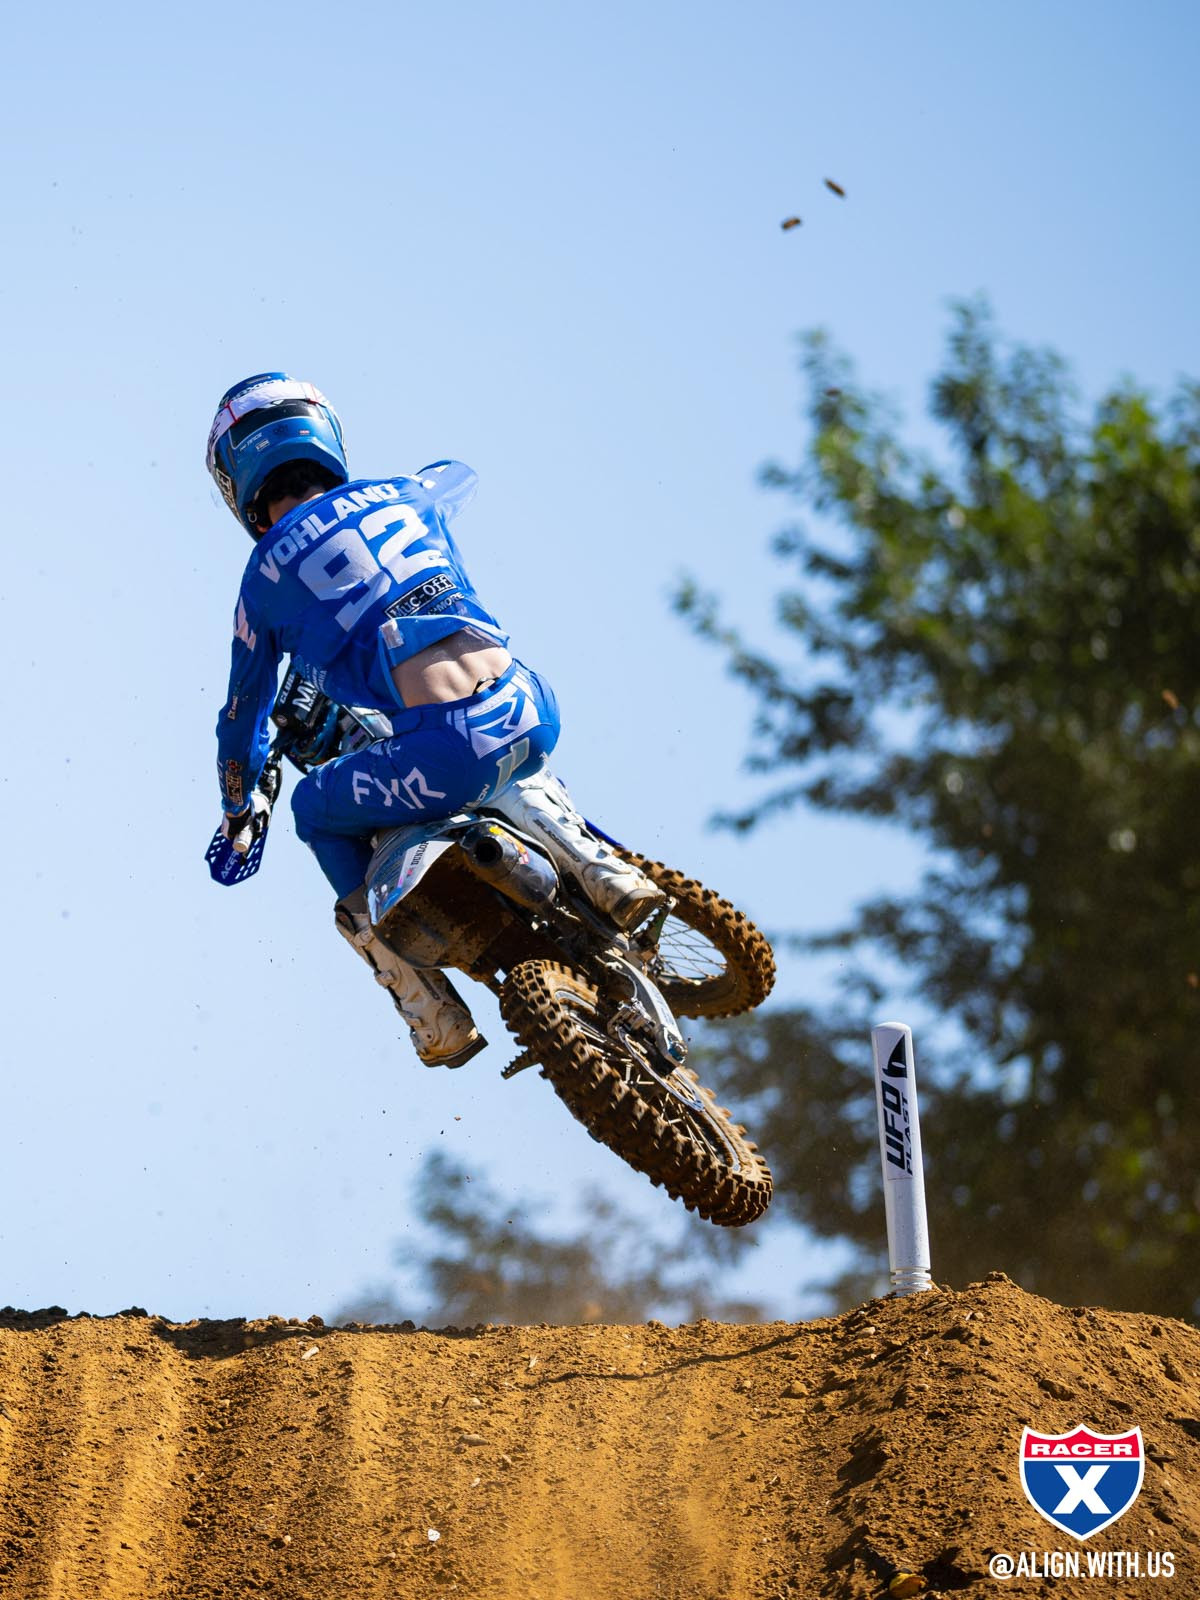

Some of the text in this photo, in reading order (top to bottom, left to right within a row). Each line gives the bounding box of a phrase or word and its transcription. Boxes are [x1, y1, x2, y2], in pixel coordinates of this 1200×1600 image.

[259, 483, 400, 584] VOHLAND
[298, 503, 451, 632] 92
[352, 766, 447, 810] FXR
[881, 1080, 905, 1170] UFO
[900, 1092, 913, 1175] PLAST
